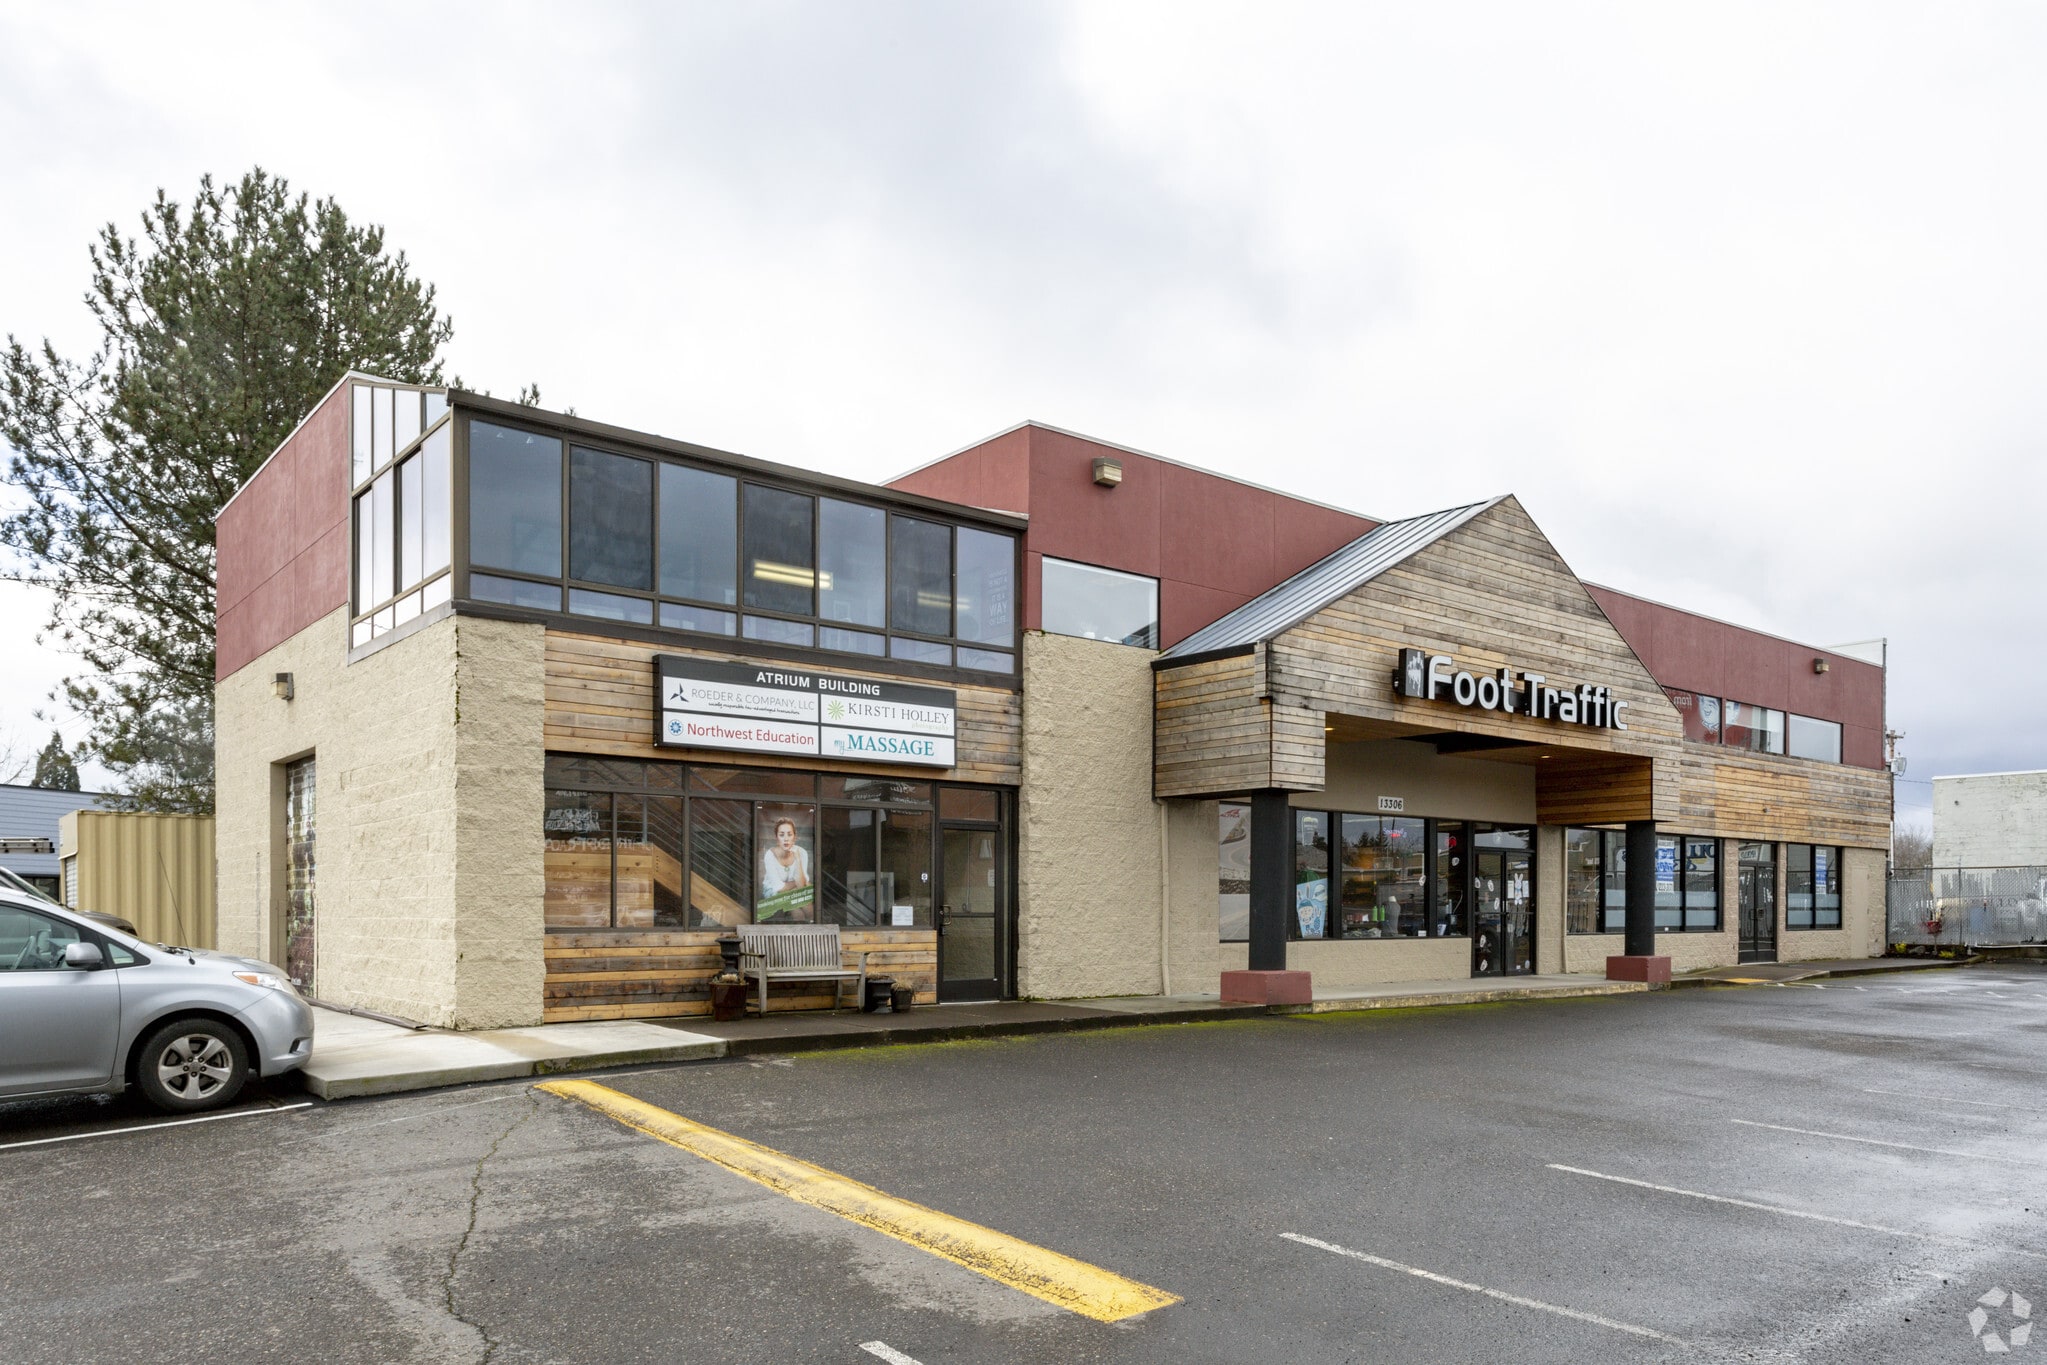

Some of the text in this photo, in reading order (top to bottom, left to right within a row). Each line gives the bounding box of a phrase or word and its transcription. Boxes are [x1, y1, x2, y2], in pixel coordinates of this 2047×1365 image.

[990, 600, 1007, 616] WAY
[756, 671, 881, 696] ATRIUM BUILDING
[1428, 655, 1629, 730] Foot Traffic
[691, 688, 734, 701] ROEDER
[736, 693, 743, 703] &
[798, 700, 815, 711] LLC
[848, 702, 950, 724] KIRSTI HOLLEY
[687, 722, 814, 745] Northwest Education
[834, 733, 935, 757] my MASSAGE
[1380, 798, 1403, 810] 13306
